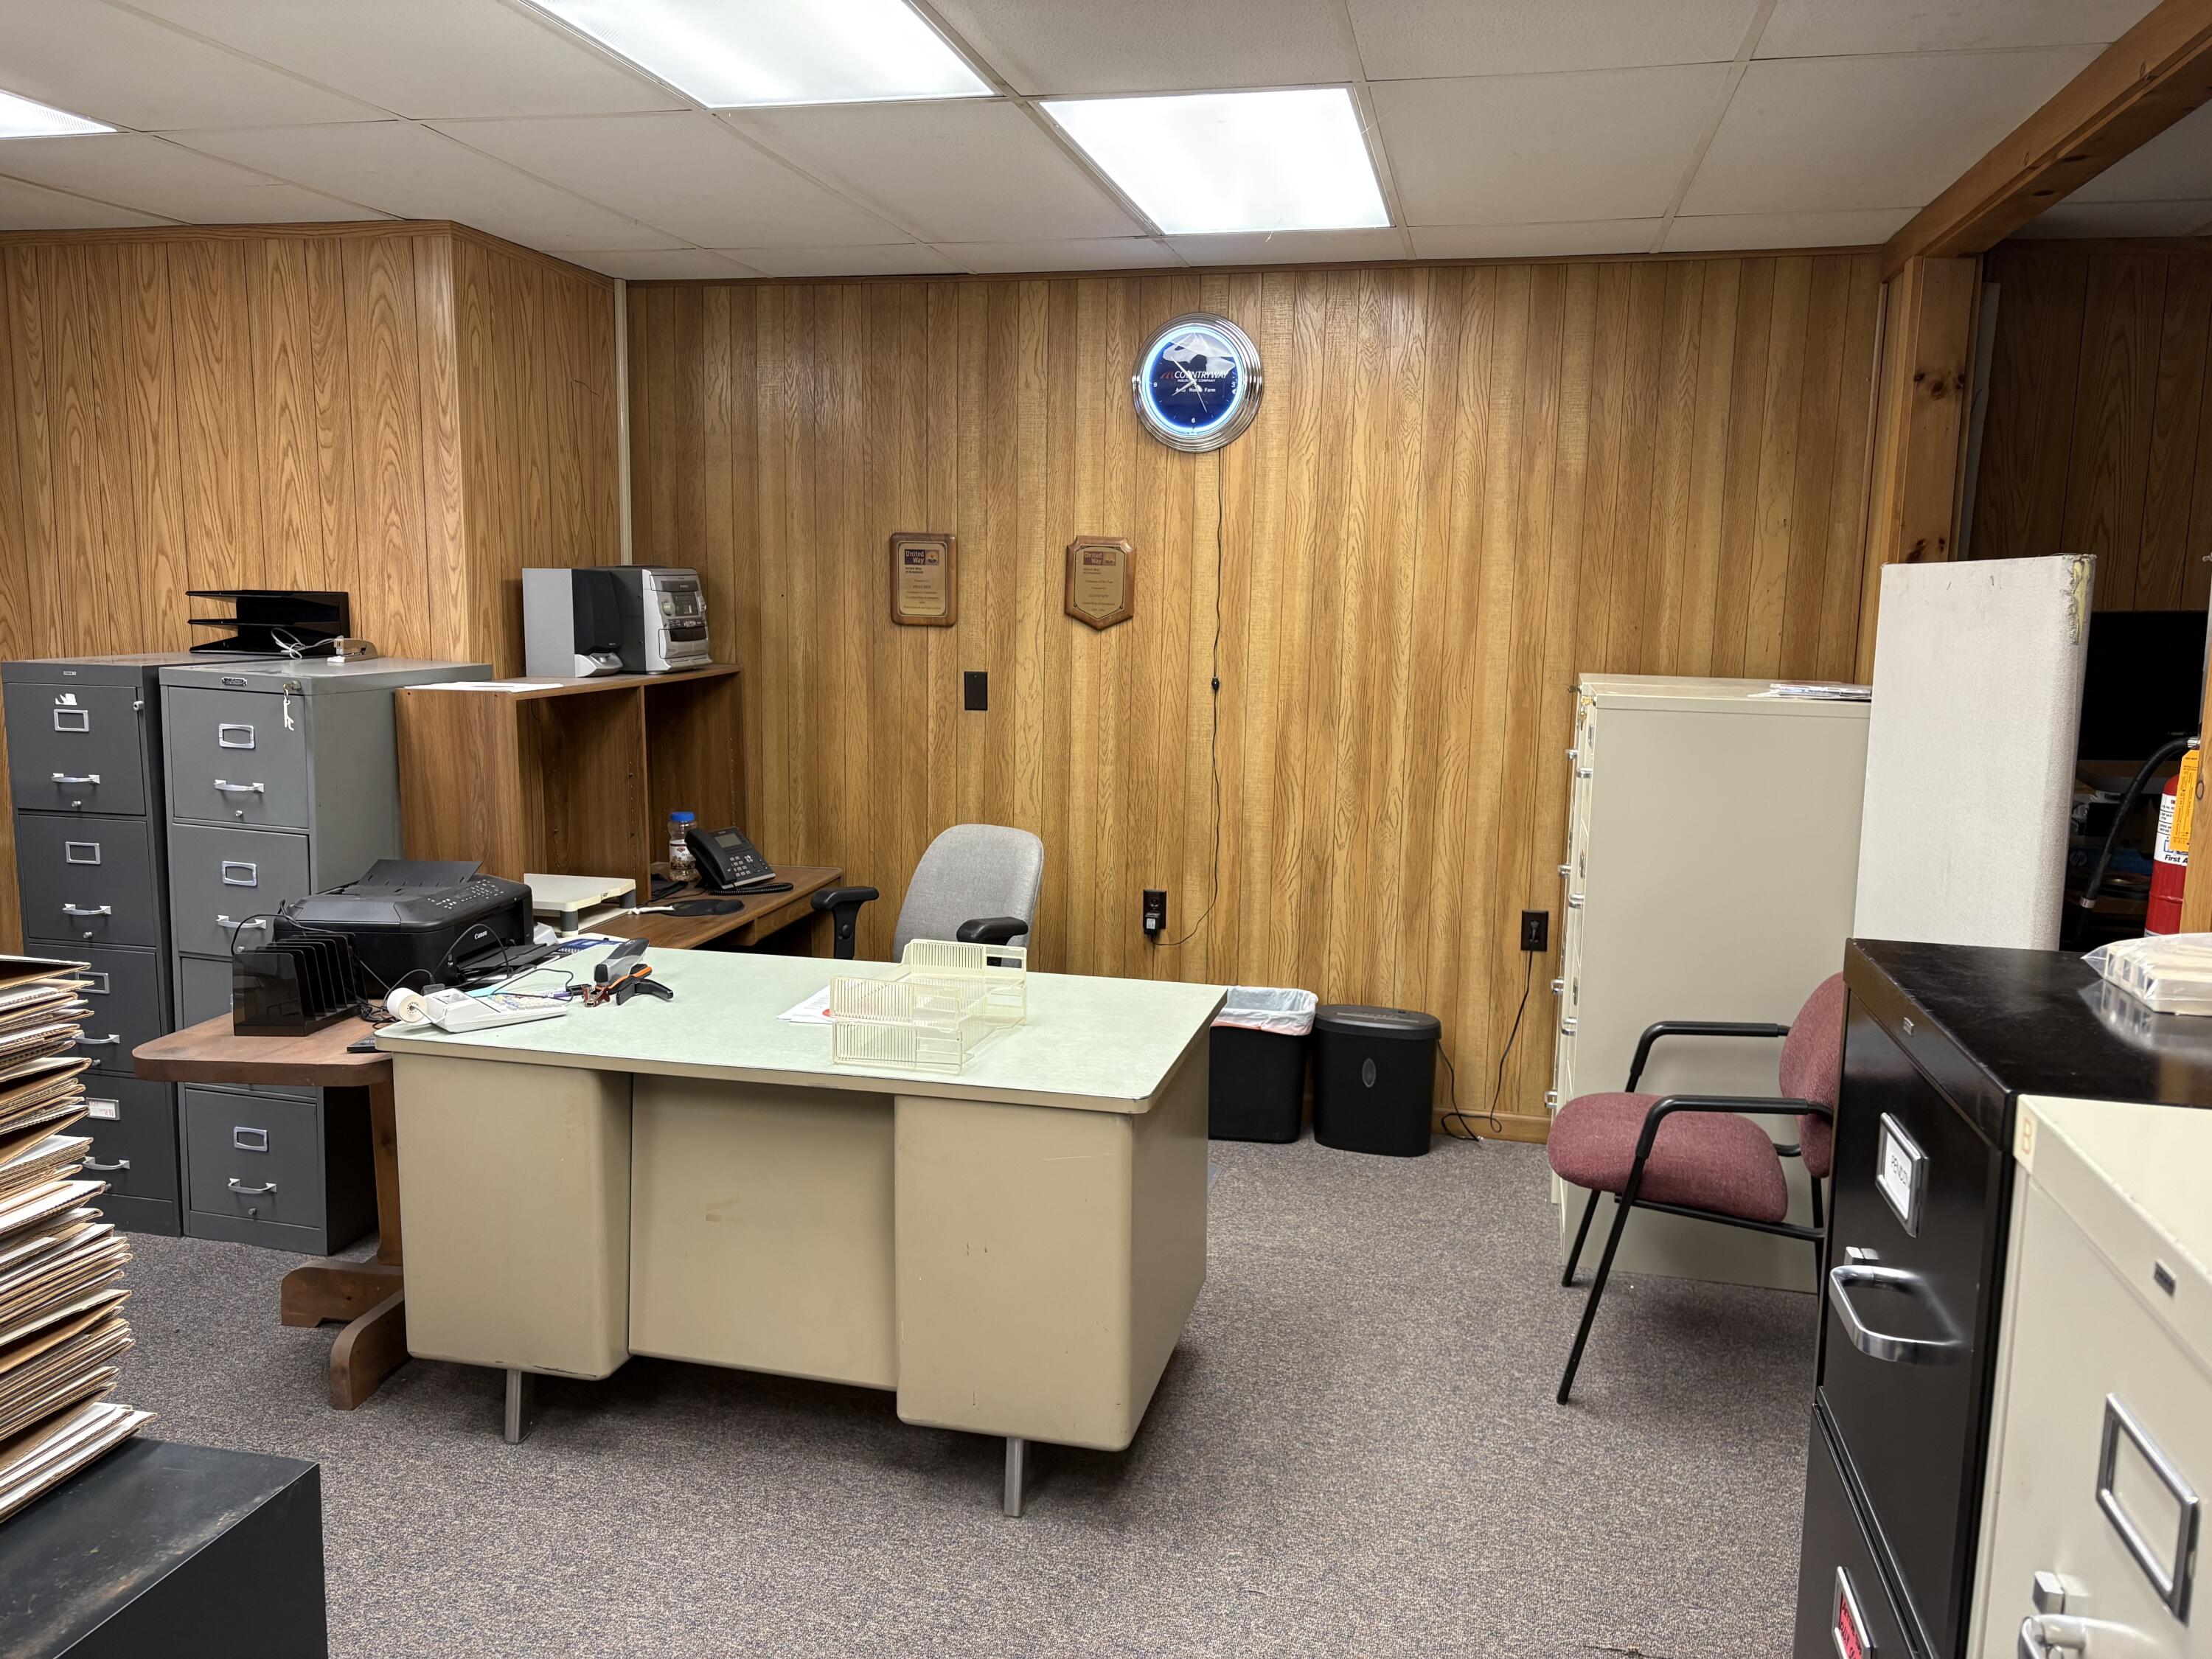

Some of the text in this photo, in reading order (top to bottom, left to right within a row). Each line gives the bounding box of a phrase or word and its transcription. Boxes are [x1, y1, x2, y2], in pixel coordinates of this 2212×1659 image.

[913, 557, 925, 565] Way
[2164, 854, 2181, 863] First
[474, 931, 488, 939] Canon
